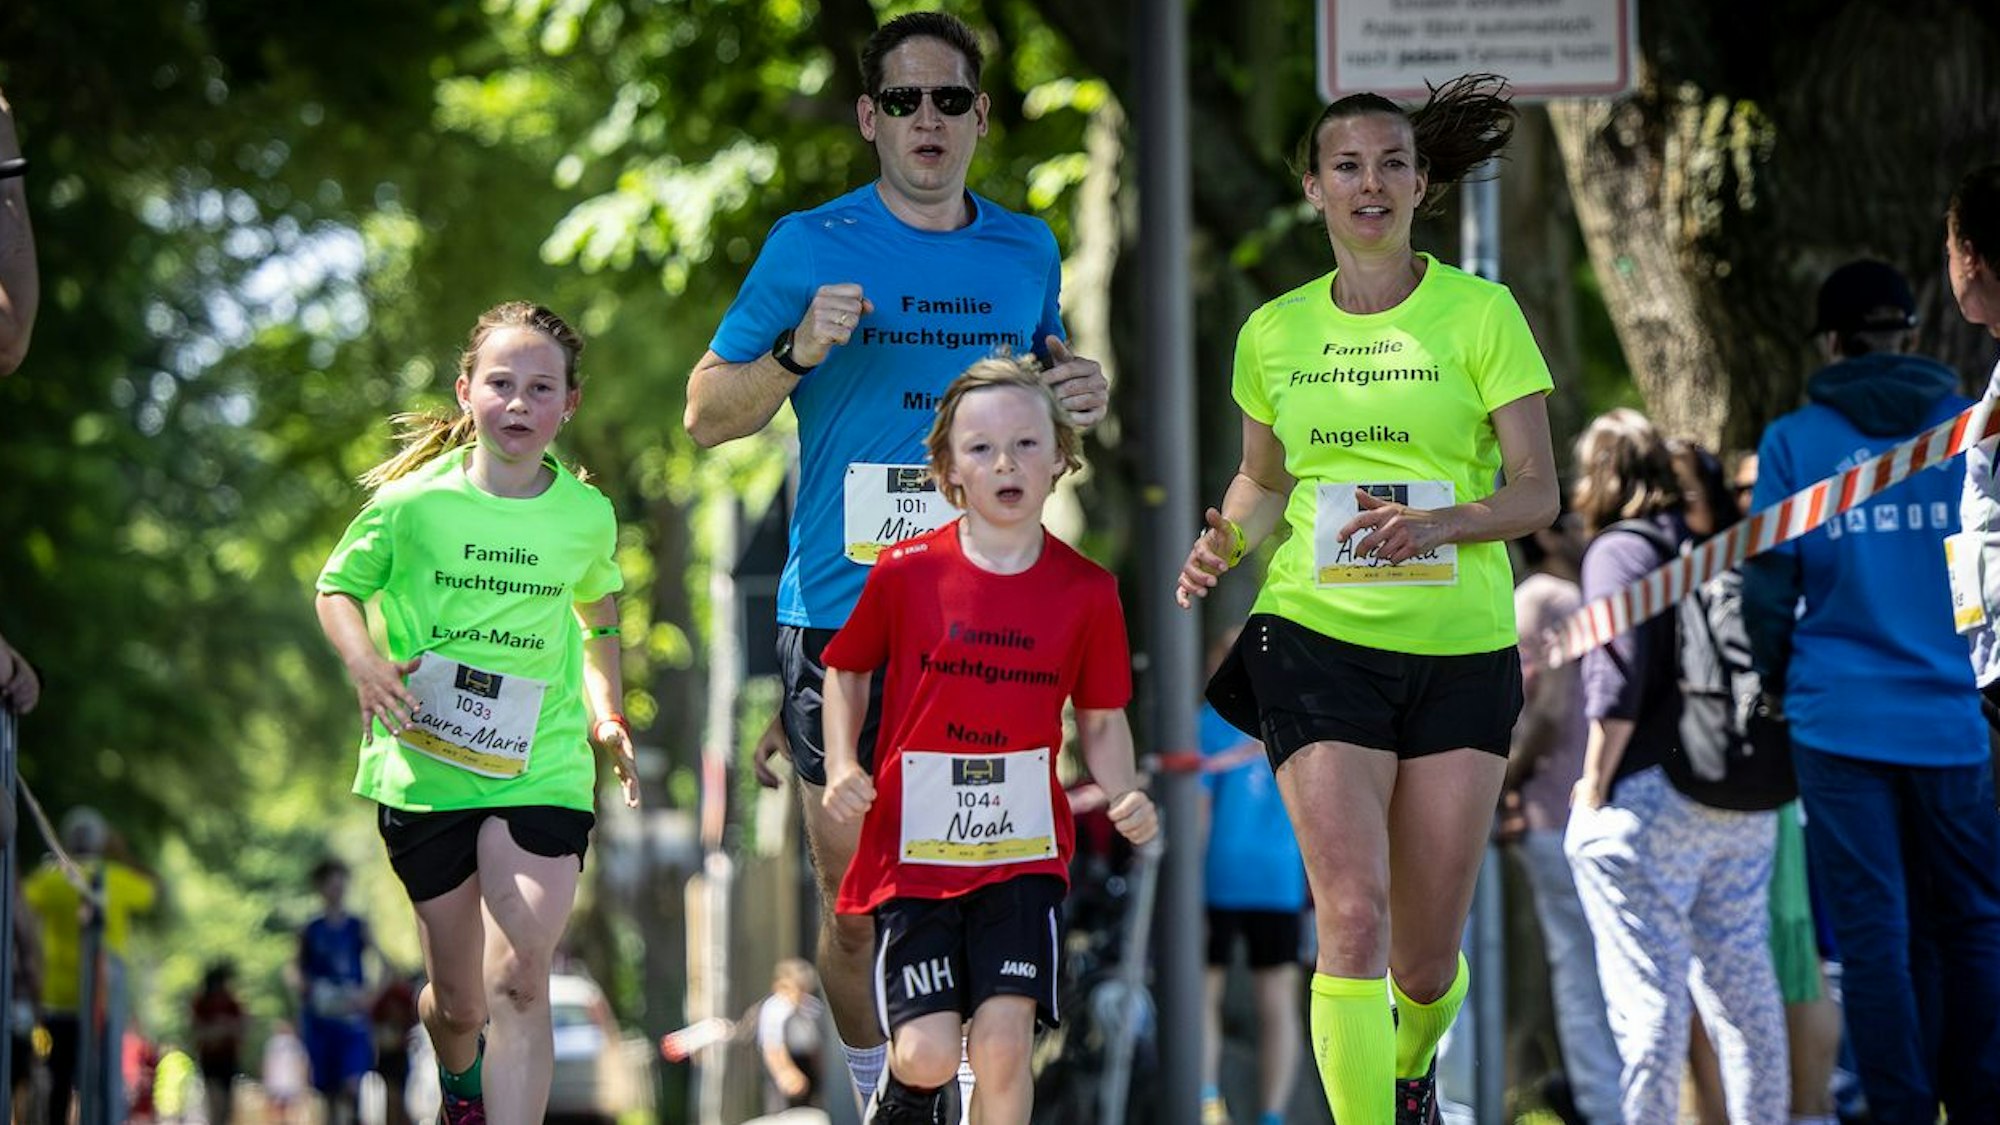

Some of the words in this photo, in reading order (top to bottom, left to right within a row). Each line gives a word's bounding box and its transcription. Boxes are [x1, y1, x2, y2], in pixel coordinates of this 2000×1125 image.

[901, 296, 993, 314] Familie
[862, 327, 1025, 349] Fruchtgummi
[1323, 340, 1404, 356] Familie
[1289, 365, 1440, 387] Fruchtgummi
[1310, 425, 1410, 447] Angelika
[464, 543, 540, 566] Familie
[435, 570, 566, 597] Fruchtgummi
[950, 622, 1037, 650] Familie
[946, 723, 1009, 747] Noah
[946, 810, 1015, 841] Noah
[902, 957, 955, 999] NH
[1000, 960, 1037, 979] JAKO
